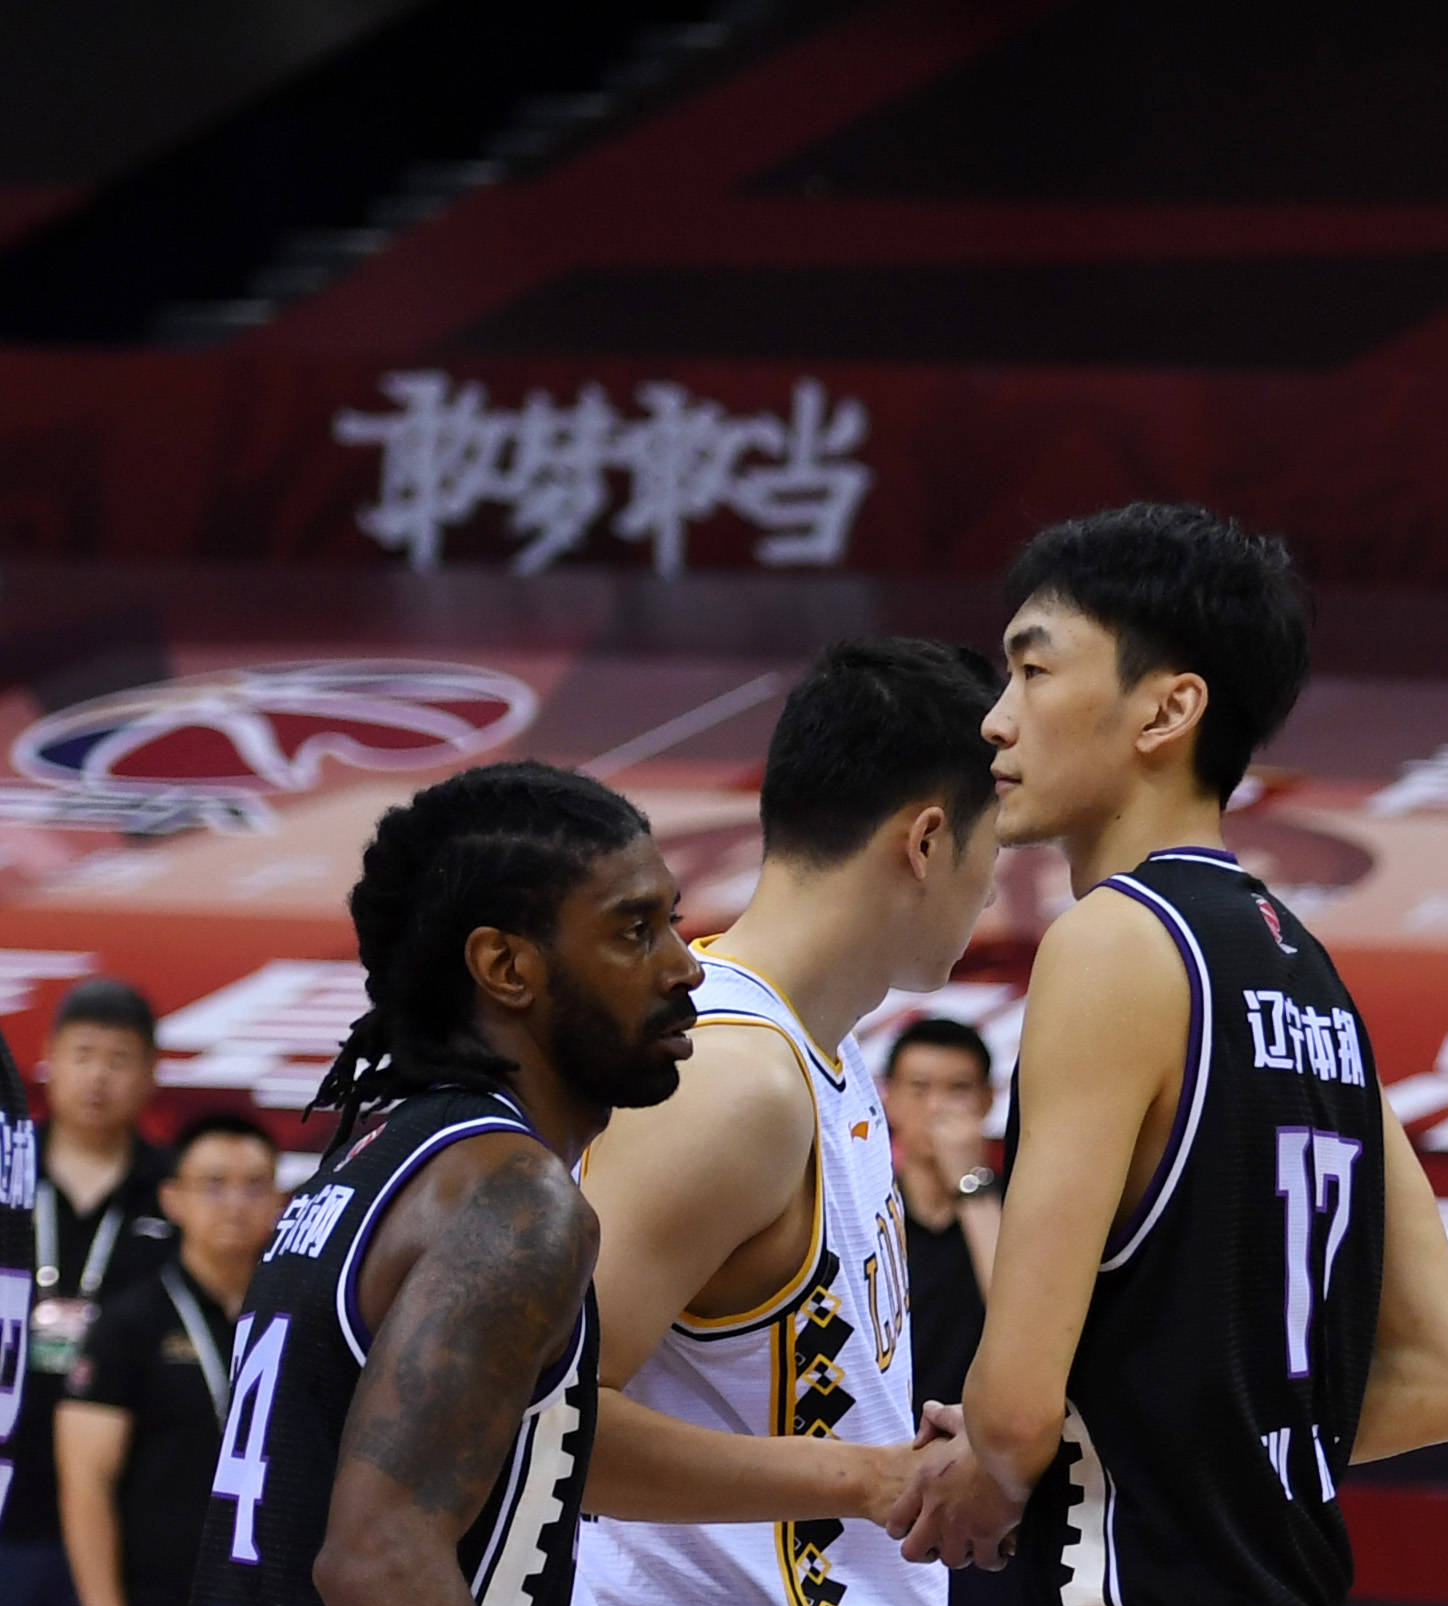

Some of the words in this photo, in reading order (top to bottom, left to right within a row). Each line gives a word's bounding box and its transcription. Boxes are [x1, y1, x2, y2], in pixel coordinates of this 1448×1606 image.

[335, 370, 870, 575] 敢梦敢当
[1274, 1125, 1362, 1378] 17
